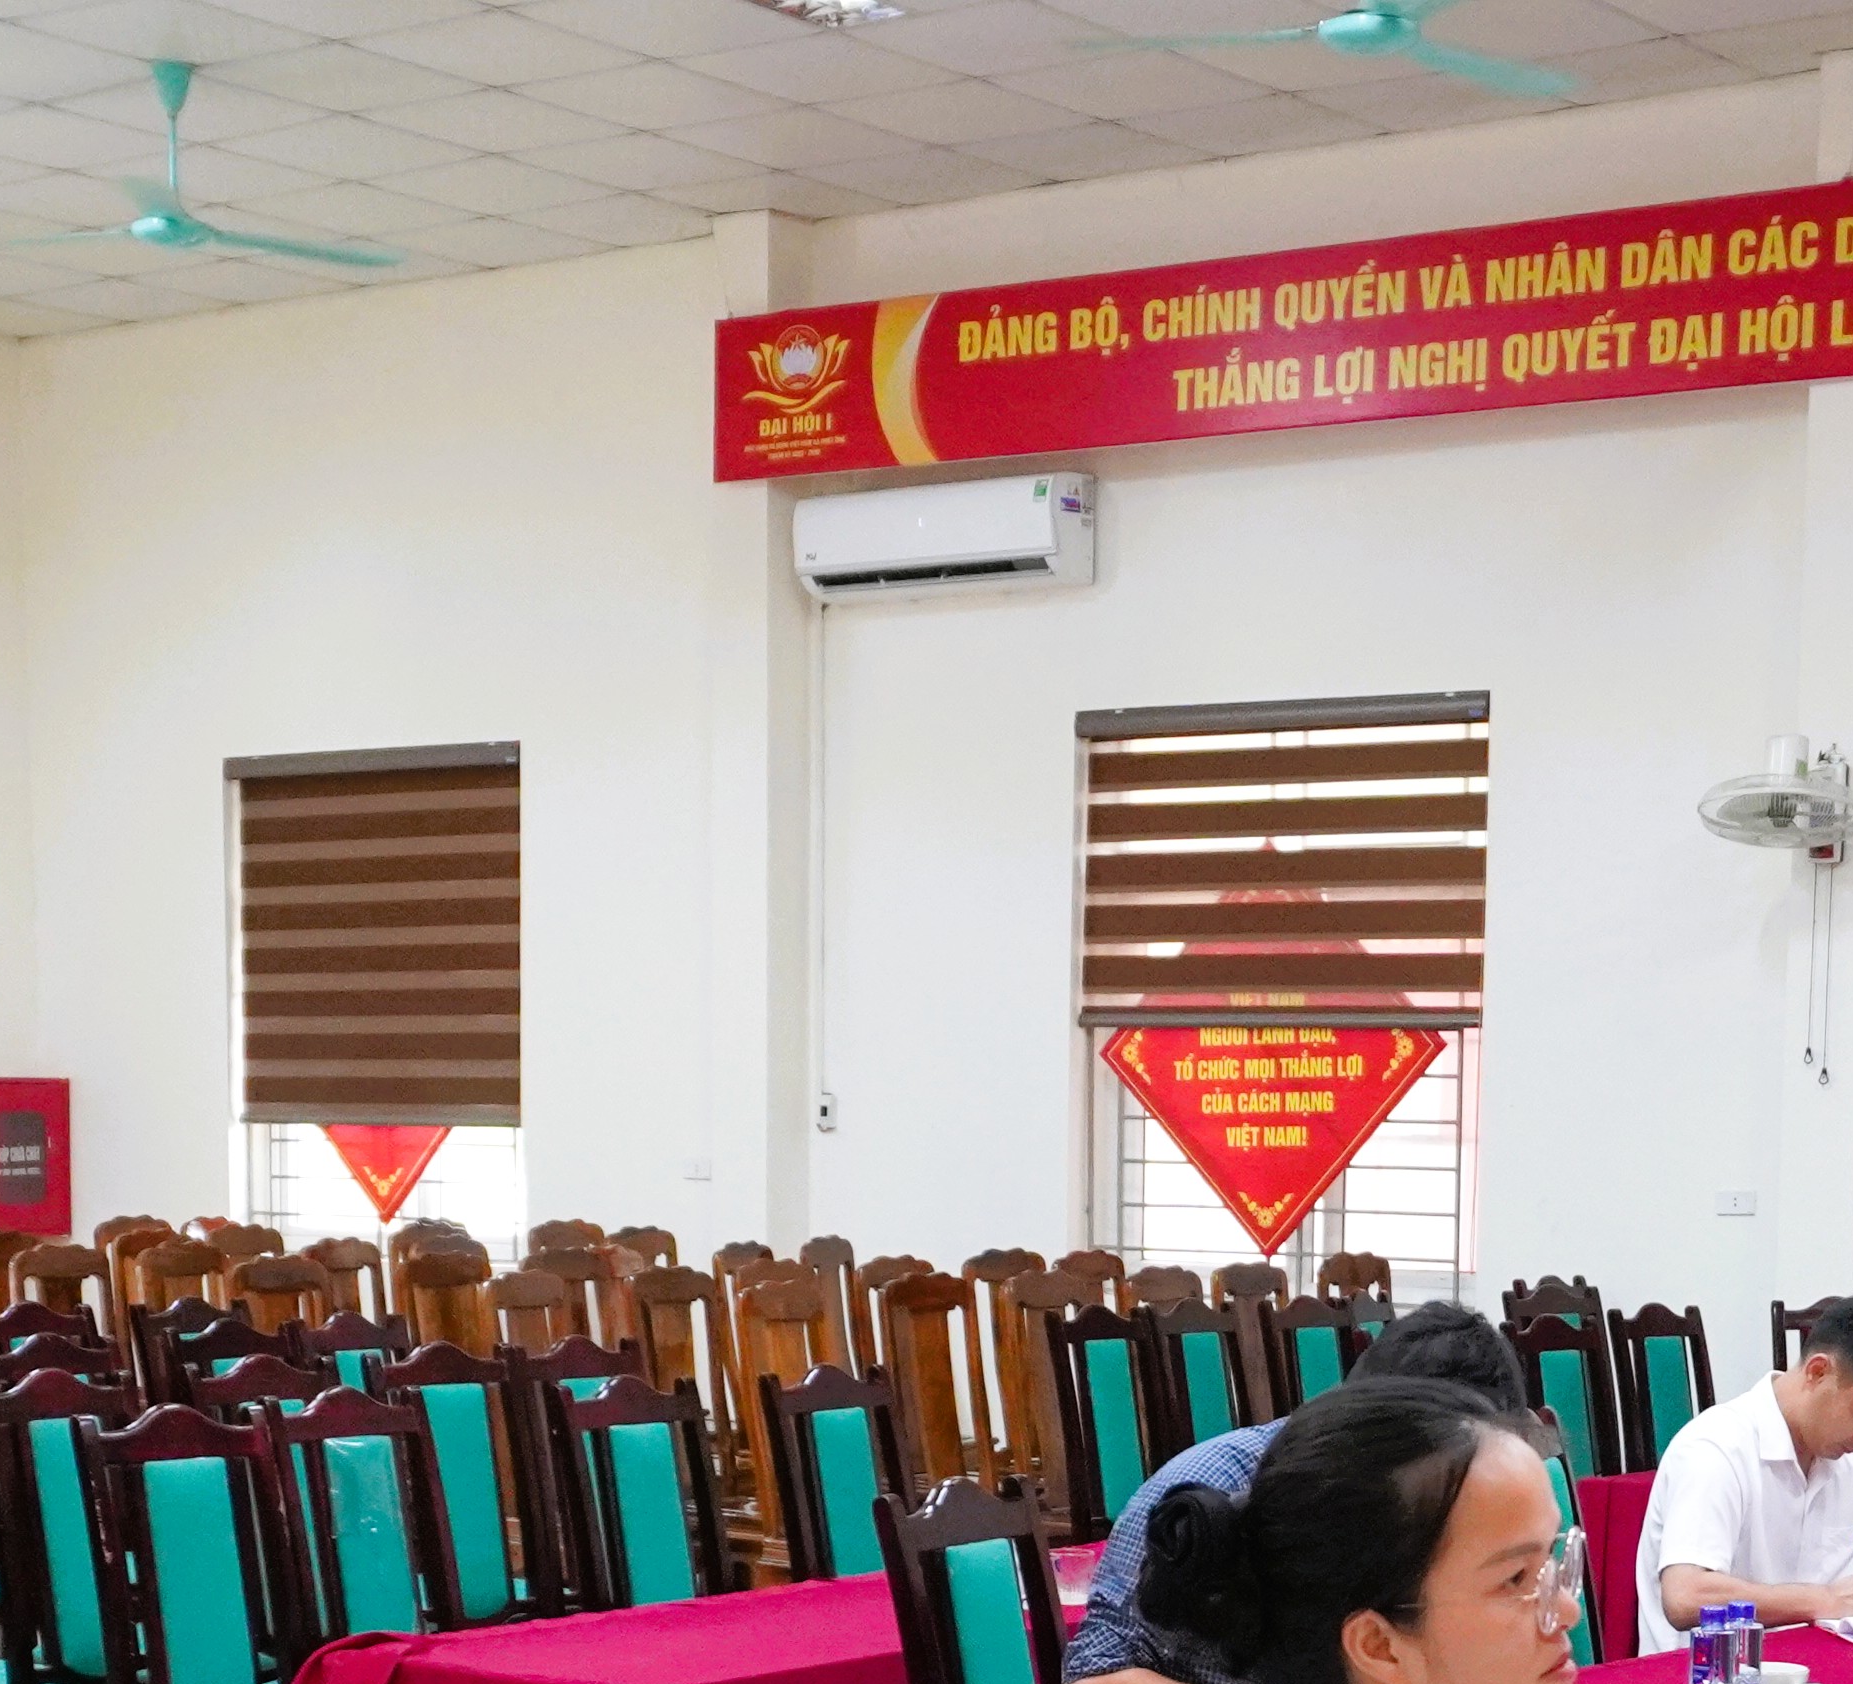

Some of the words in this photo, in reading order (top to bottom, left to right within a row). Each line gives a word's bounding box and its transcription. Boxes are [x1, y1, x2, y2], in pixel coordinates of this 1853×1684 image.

[958, 304, 1057, 363] ĐẢNG
[1069, 296, 1129, 356] BỘ,
[1143, 285, 1261, 342] CHÍNH
[1274, 259, 1406, 331] QUYỀN
[1419, 254, 1472, 310] VÀ
[1485, 241, 1607, 303] NHÂN
[1621, 229, 1712, 289] DÂN
[1728, 215, 1819, 276] CÁC
[1172, 347, 1300, 412] THẮNG
[1313, 346, 1376, 404] LỢI
[1388, 337, 1488, 392] NGHỊ
[1502, 309, 1637, 382] QUYẾT
[1648, 312, 1723, 371] ĐẠI
[1738, 294, 1814, 362] HỘI
[758, 416, 788, 439] ĐẠI
[792, 411, 821, 435] HỘI
[825, 412, 833, 431] I
[1174, 1053, 1195, 1081] TỔ
[1197, 1055, 1241, 1080] CHỨC
[1244, 1057, 1276, 1083] MỌI
[1337, 1053, 1363, 1082] LỢI
[1201, 1086, 1234, 1114] CỦA
[1238, 1088, 1280, 1113] CÁCH
[1285, 1091, 1334, 1117] MẠNG
[1226, 1123, 1260, 1151] VIỆT
[1263, 1126, 1307, 1147] NAM!
